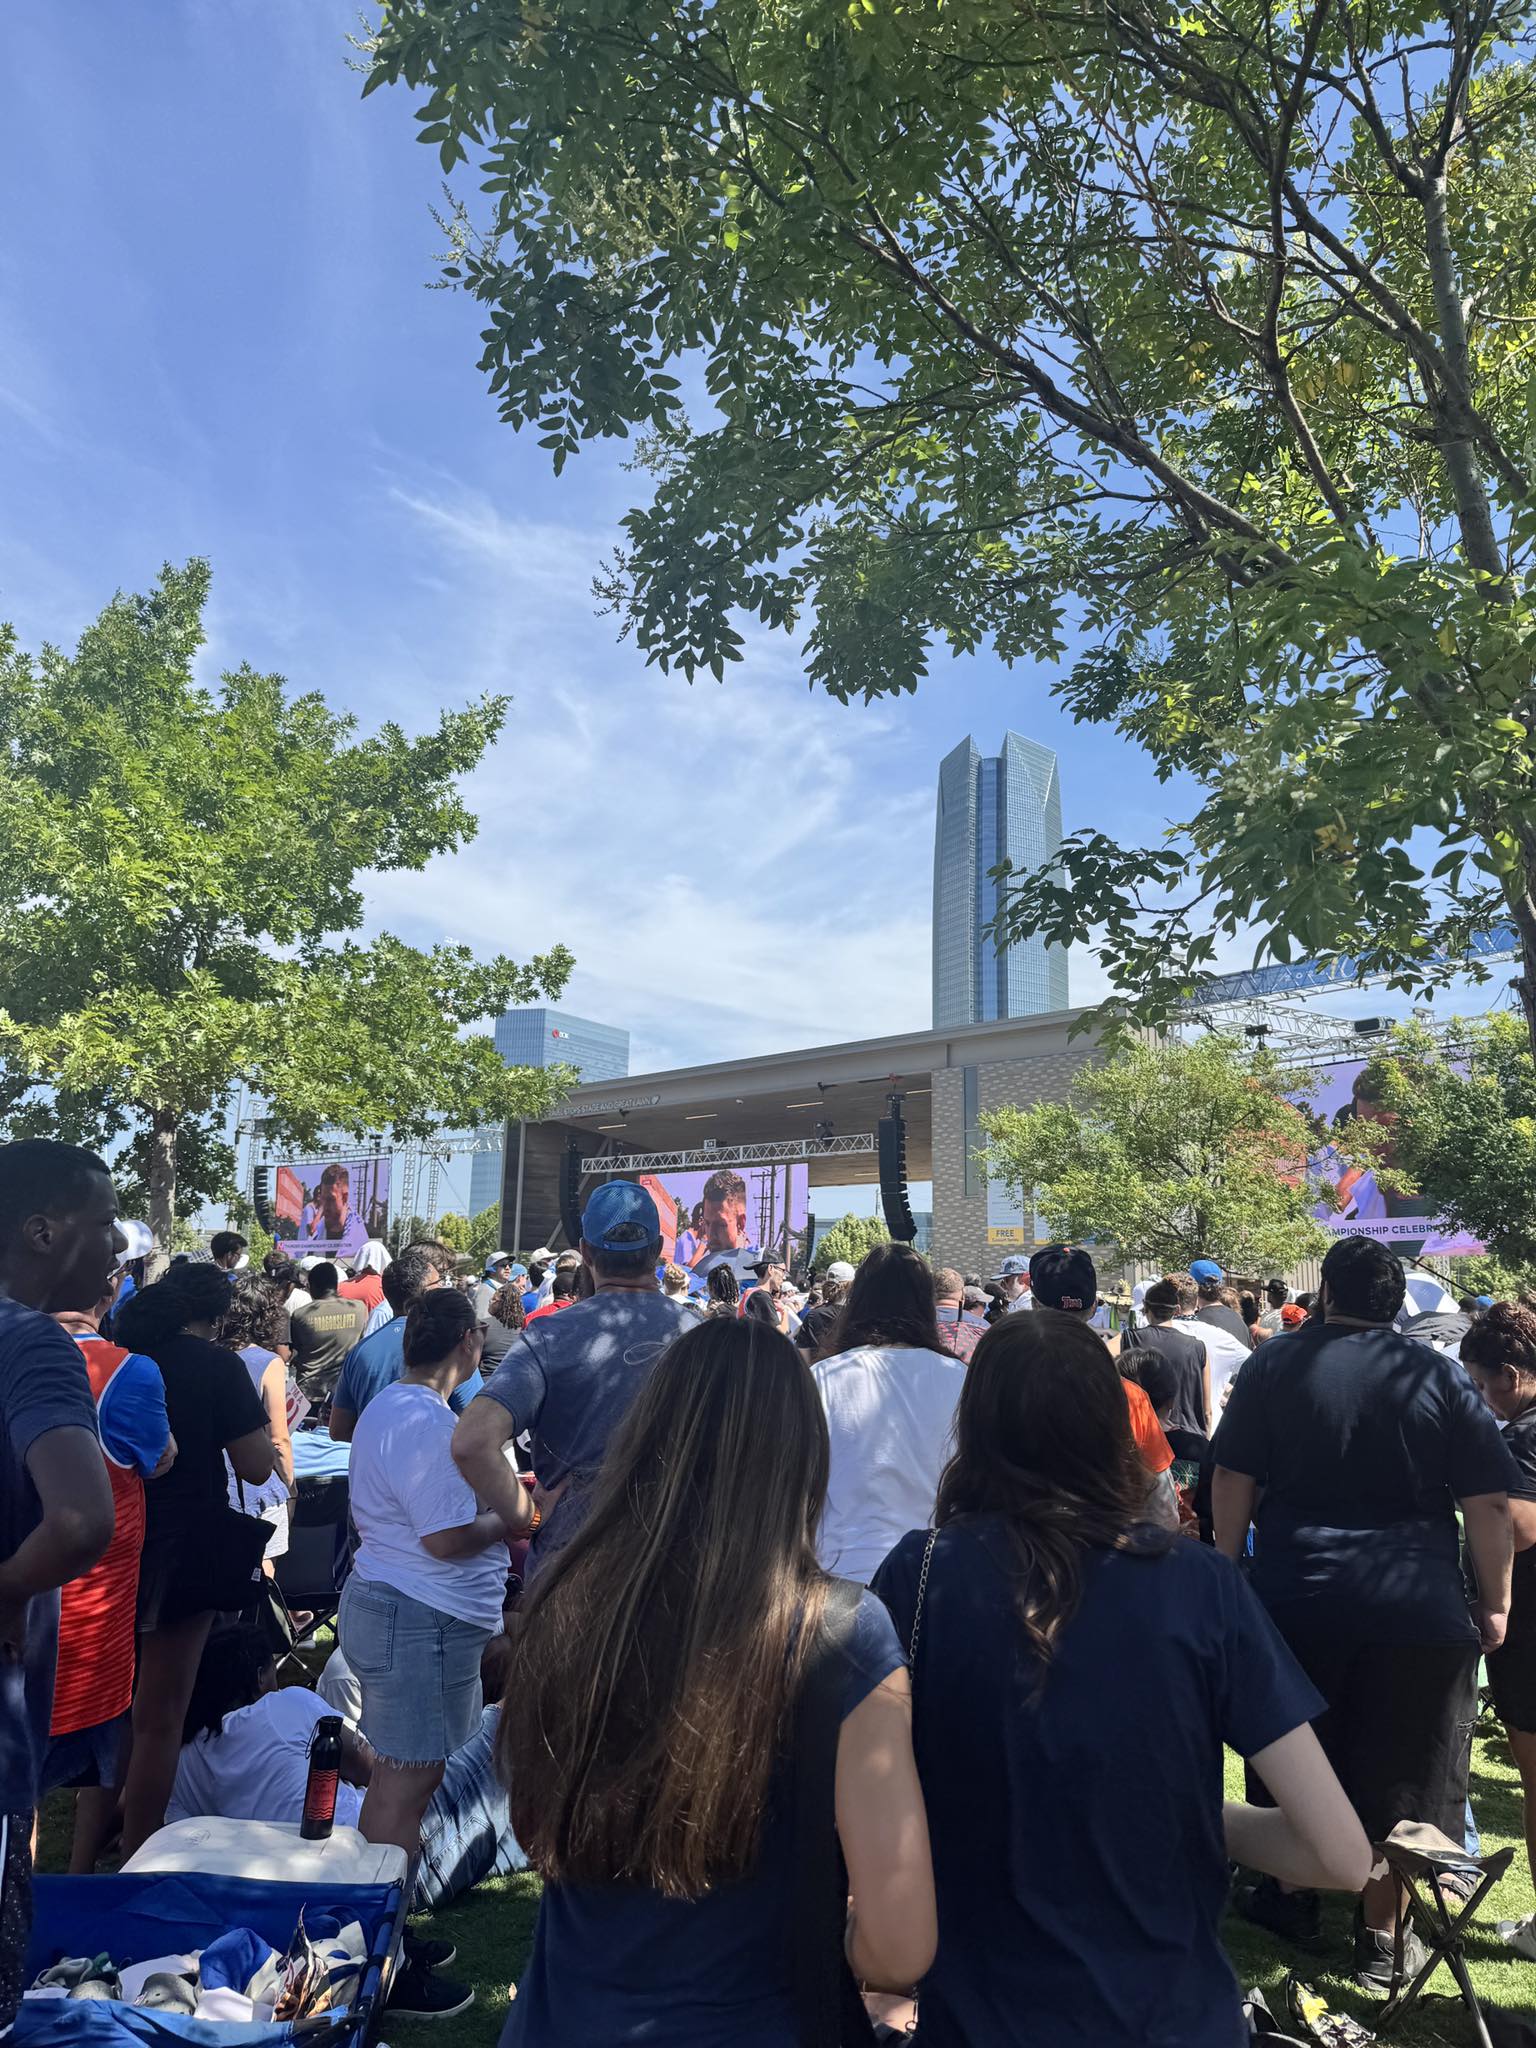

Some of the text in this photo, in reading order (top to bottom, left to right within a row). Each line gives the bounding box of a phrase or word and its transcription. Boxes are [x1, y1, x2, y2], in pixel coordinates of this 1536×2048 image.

[581, 1103, 600, 1114] STAGE
[600, 1102, 613, 1112] AND
[613, 1099, 632, 1110] GREAT
[632, 1097, 651, 1107] LAWN
[996, 1229, 1014, 1237] FREE
[1326, 1226, 1389, 1237] AMPIONSHIP
